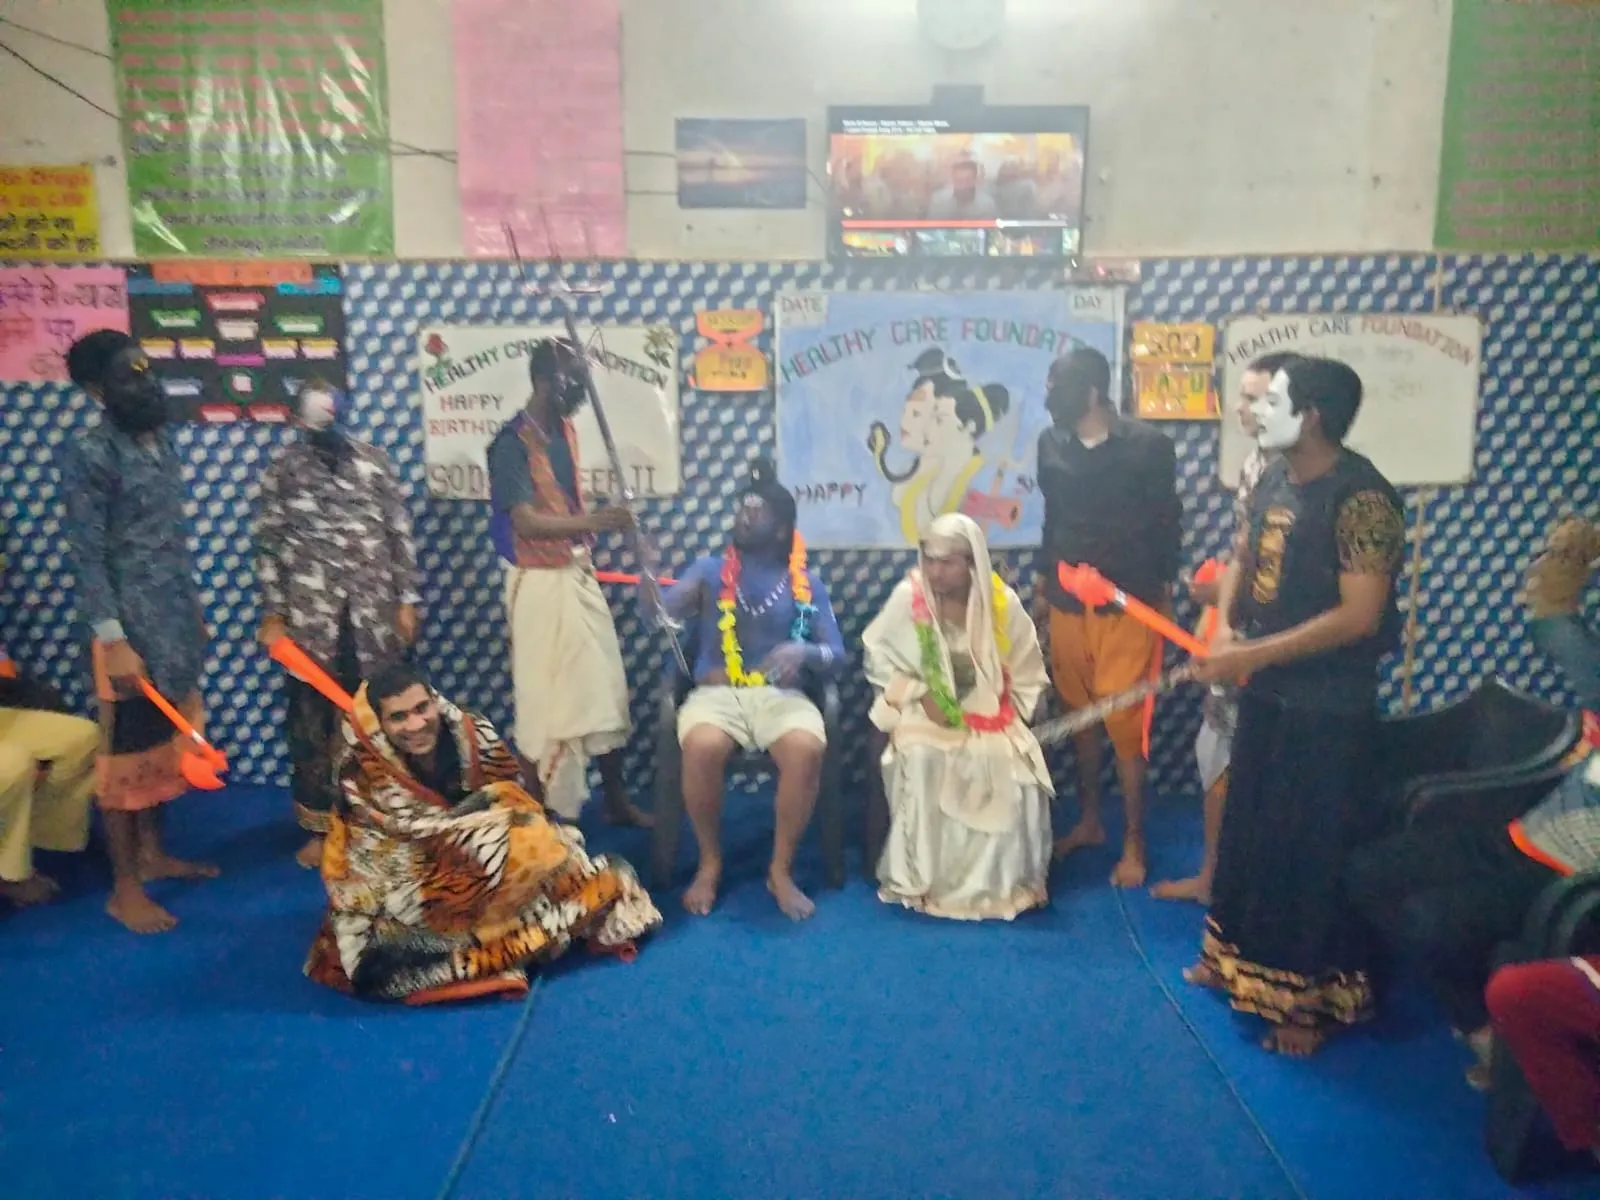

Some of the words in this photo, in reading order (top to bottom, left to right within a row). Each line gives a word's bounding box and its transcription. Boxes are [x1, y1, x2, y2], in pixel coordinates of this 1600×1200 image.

[780, 327, 876, 383] HEALTHY
[891, 316, 948, 346] CARE
[961, 317, 1085, 353] FOUNDAT
[1226, 322, 1300, 366] HEALTHY
[1309, 317, 1351, 338] CARE
[424, 346, 499, 394] HEALTHY
[504, 338, 542, 359] CAR
[439, 394, 504, 411] HAPPY
[429, 418, 500, 437] BIRTHD
[795, 481, 867, 507] HAPPY
